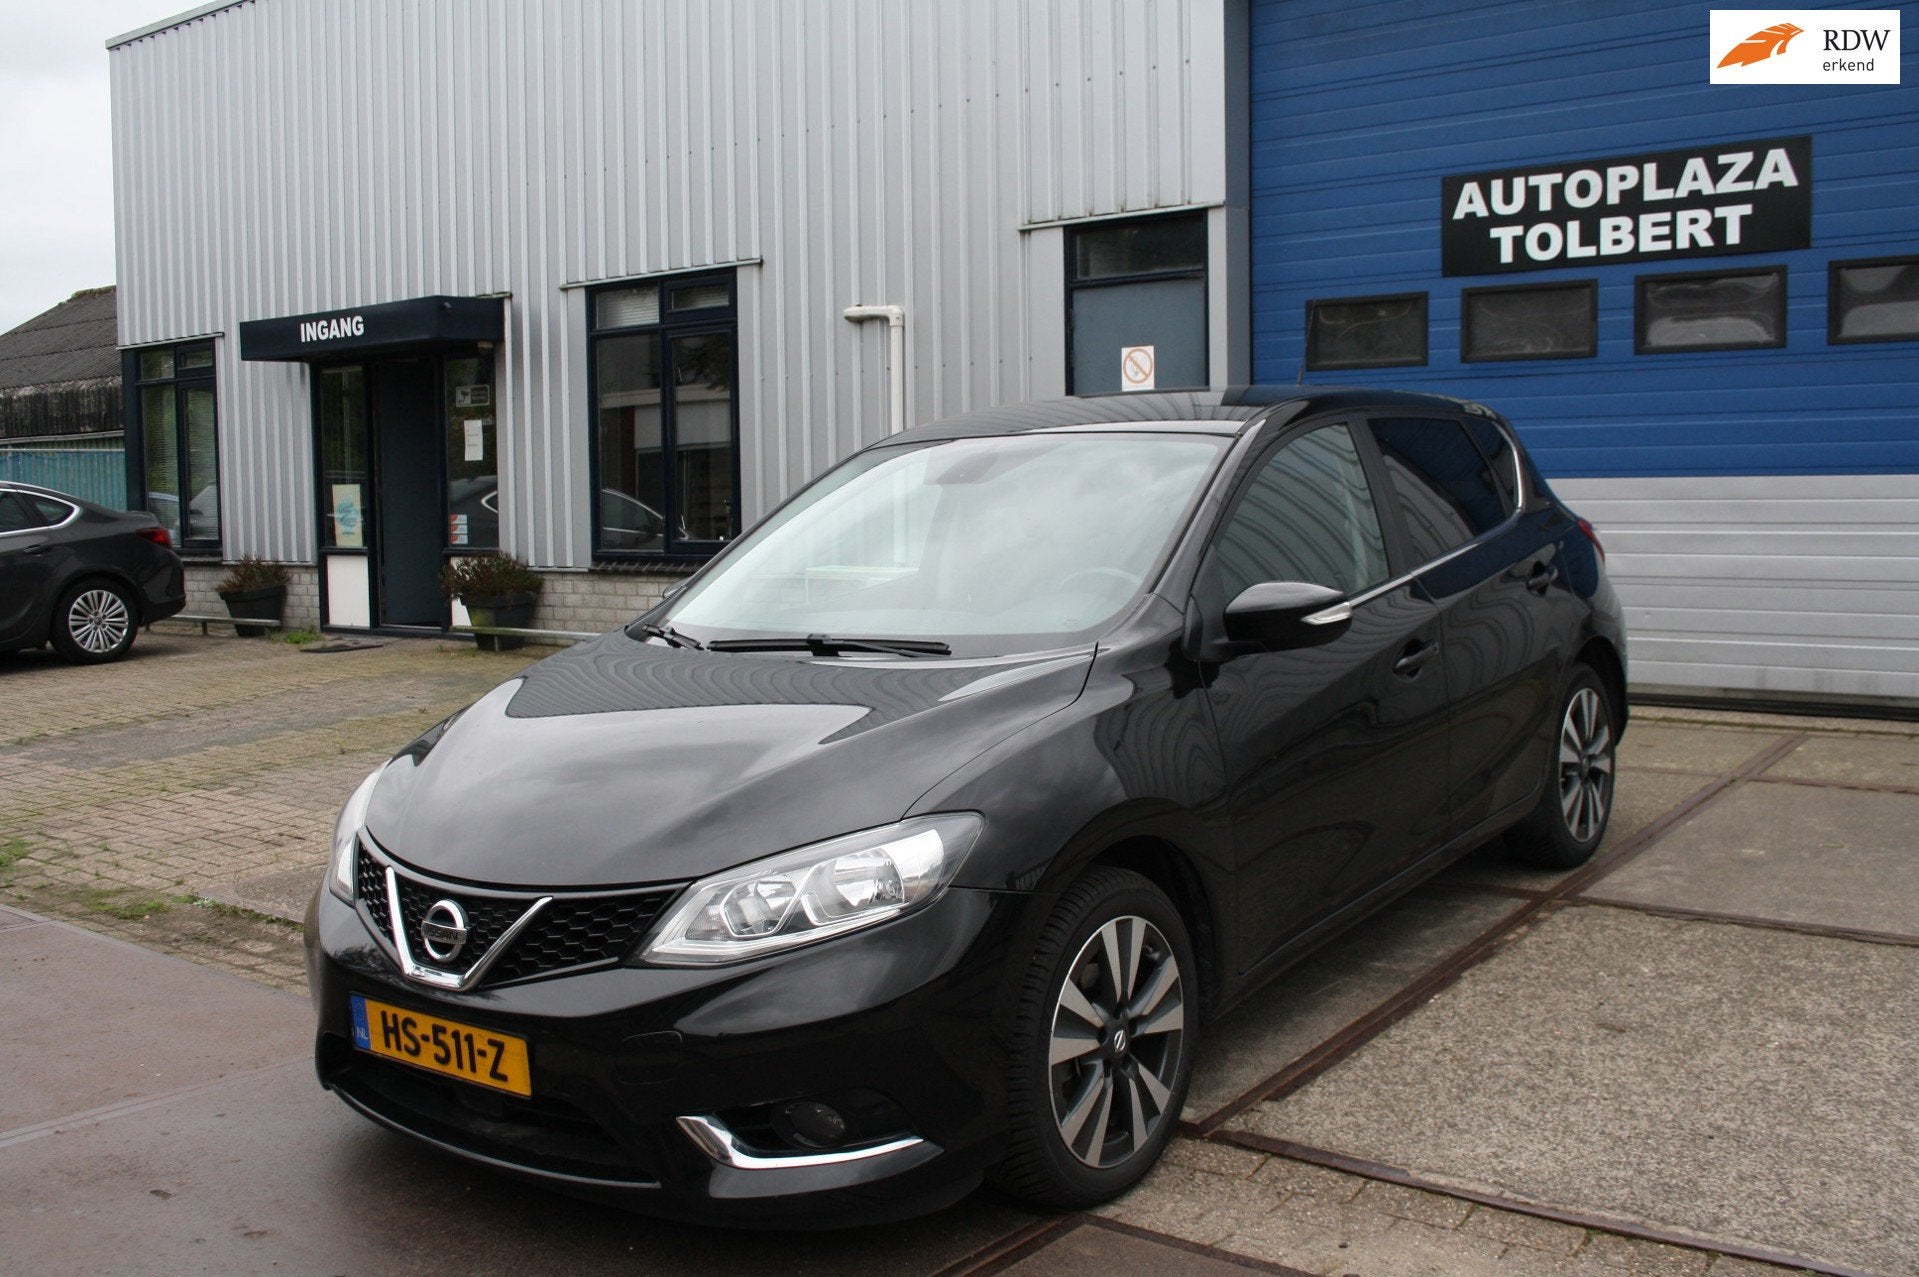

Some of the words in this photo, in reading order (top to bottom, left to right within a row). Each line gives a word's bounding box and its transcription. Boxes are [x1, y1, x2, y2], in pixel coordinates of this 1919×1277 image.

[1452, 148, 1799, 220] AUTOPLAZA
[1490, 204, 1753, 264] TOLBERT
[300, 316, 364, 343] INGANG
[356, 1026, 369, 1040] NL
[380, 1010, 508, 1082] HS-511-Z
